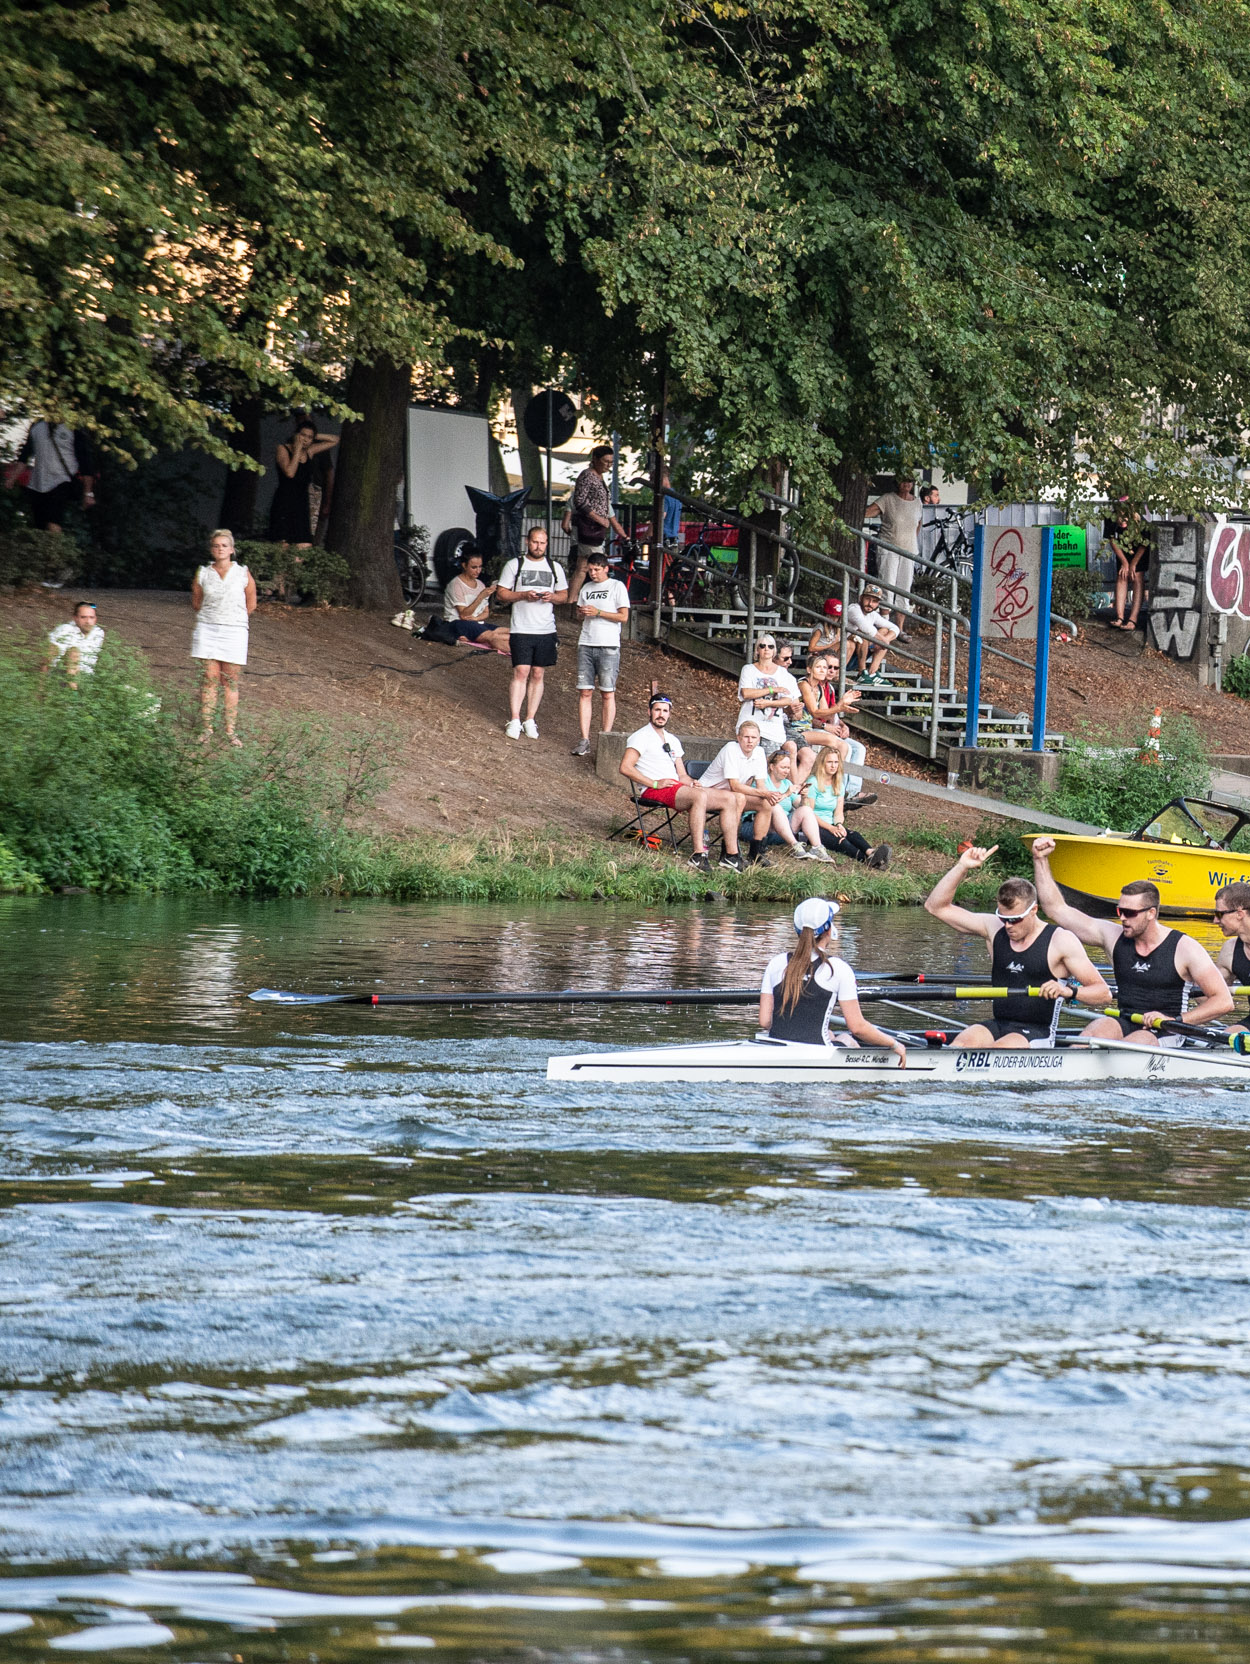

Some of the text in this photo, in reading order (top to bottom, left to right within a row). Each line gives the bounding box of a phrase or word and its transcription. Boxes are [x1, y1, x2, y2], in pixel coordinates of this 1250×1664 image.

[586, 590, 609, 600] VANS
[872, 1055, 890, 1064] Minden
[968, 1052, 1063, 1068] RBL RUDER-BUNDESLIGA
